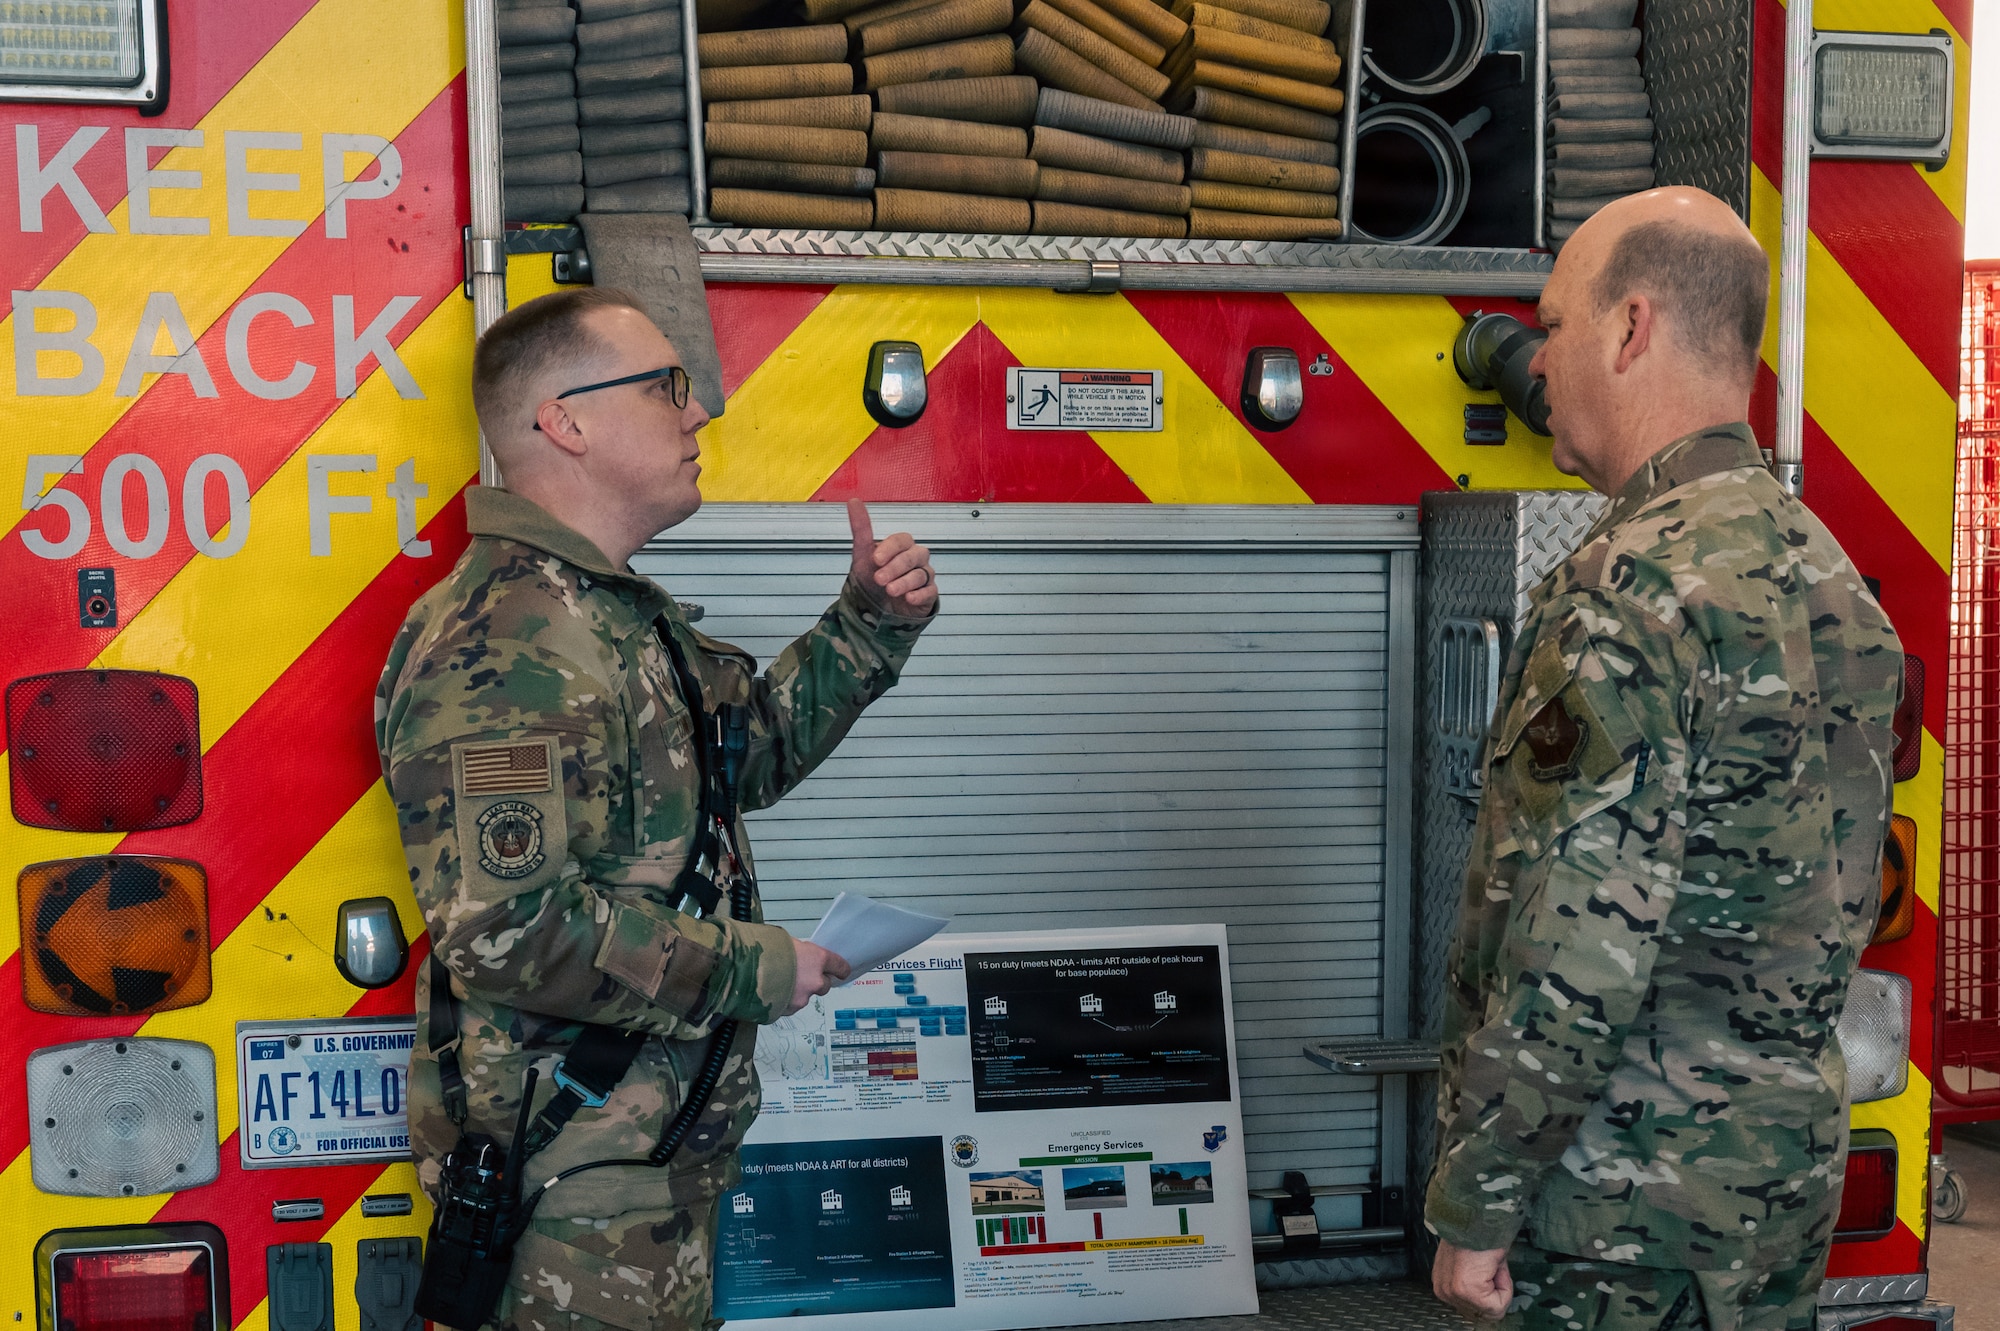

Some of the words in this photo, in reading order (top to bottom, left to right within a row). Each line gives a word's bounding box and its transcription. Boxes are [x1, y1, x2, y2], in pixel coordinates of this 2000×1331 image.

[15, 124, 402, 239] KEEP
[11, 290, 426, 400] BACK
[20, 453, 250, 560] 500
[307, 454, 432, 558] Ft
[930, 958, 963, 969] Flight
[1002, 961, 1019, 970] duty
[1021, 960, 1049, 969] (meets
[1122, 956, 1151, 964] outside
[1162, 955, 1180, 965] peak
[1089, 968, 1128, 978] populace)
[314, 1038, 339, 1052] U.S.
[262, 1050, 273, 1059] 07
[254, 1067, 408, 1122] AF14L0
[254, 1134, 261, 1149] B
[317, 1140, 337, 1151] FOR
[341, 1138, 387, 1150] OFFICIAL
[390, 1136, 410, 1147] USE
[1048, 1144, 1100, 1153] Emergency
[1104, 1141, 1144, 1150] Services
[746, 1164, 763, 1175] duty
[765, 1163, 794, 1174] (meets
[795, 1161, 821, 1171] NDAA
[822, 1161, 828, 1170] &
[830, 1160, 846, 1169] ART
[848, 1159, 860, 1169] for
[861, 1158, 871, 1168] all
[872, 1157, 908, 1168] districts)
[452, 1196, 486, 1209] MTORLA
